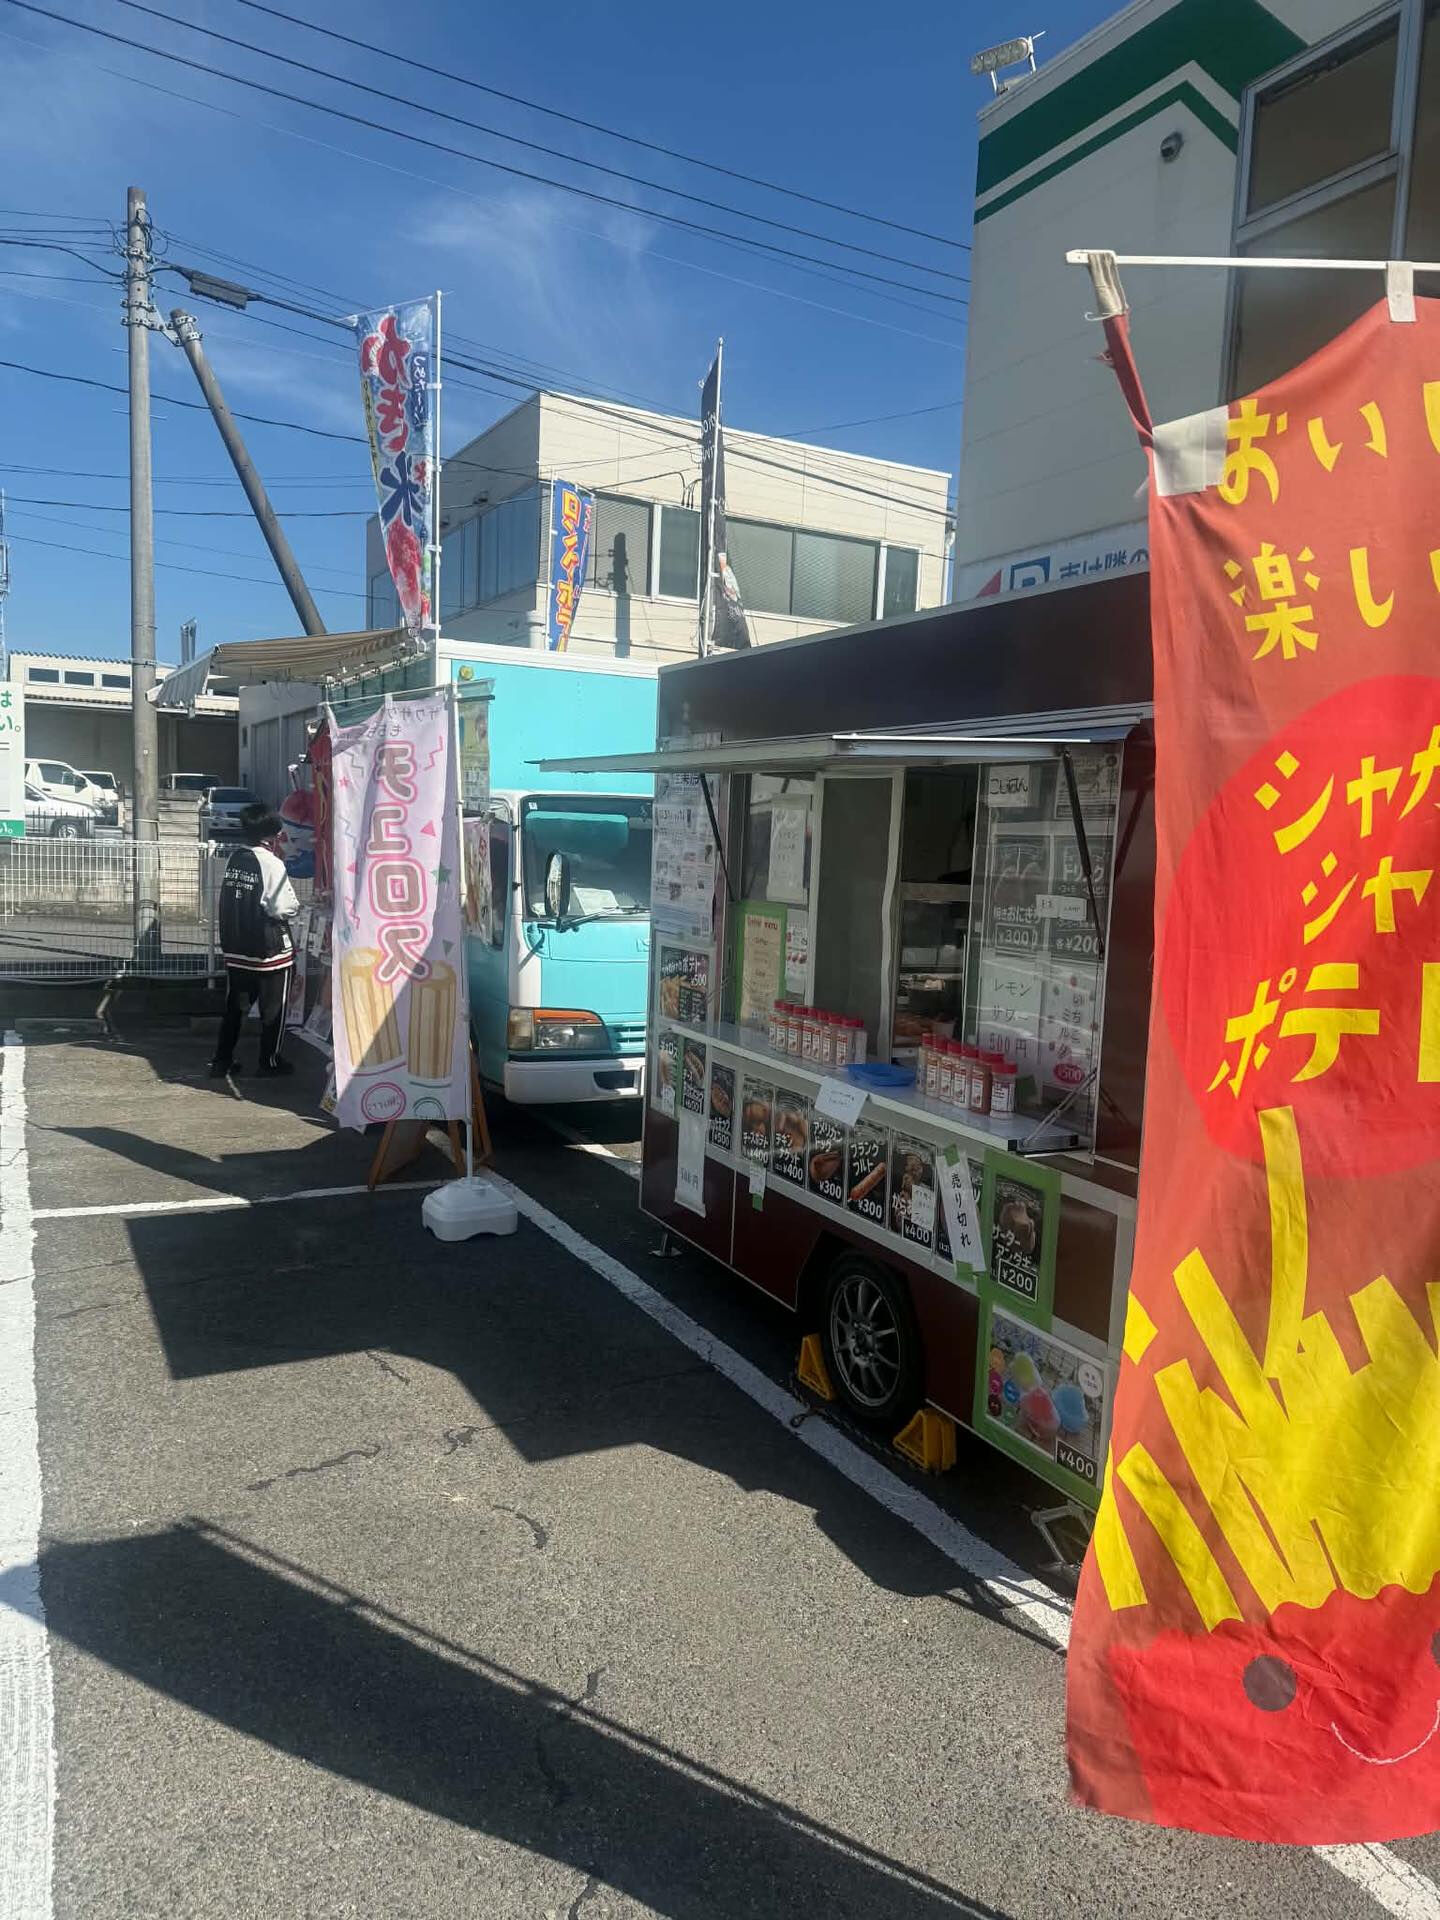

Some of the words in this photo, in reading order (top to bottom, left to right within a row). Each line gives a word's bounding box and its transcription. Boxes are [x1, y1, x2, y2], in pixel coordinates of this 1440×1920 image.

[1223, 541, 1440, 661] 楽し
[813, 1120, 844, 1143] アメリカン
[850, 1141, 880, 1158] フランク
[782, 1163, 804, 1181] ¥400
[852, 1158, 875, 1176] フルト
[819, 1179, 842, 1200] ¥300
[858, 1199, 883, 1219] ¥300
[951, 1172, 972, 1248] 売り切れ
[904, 1223, 930, 1245] ¥400
[1001, 1269, 1034, 1293] ¥200
[1058, 1449, 1095, 1479] ¥400
